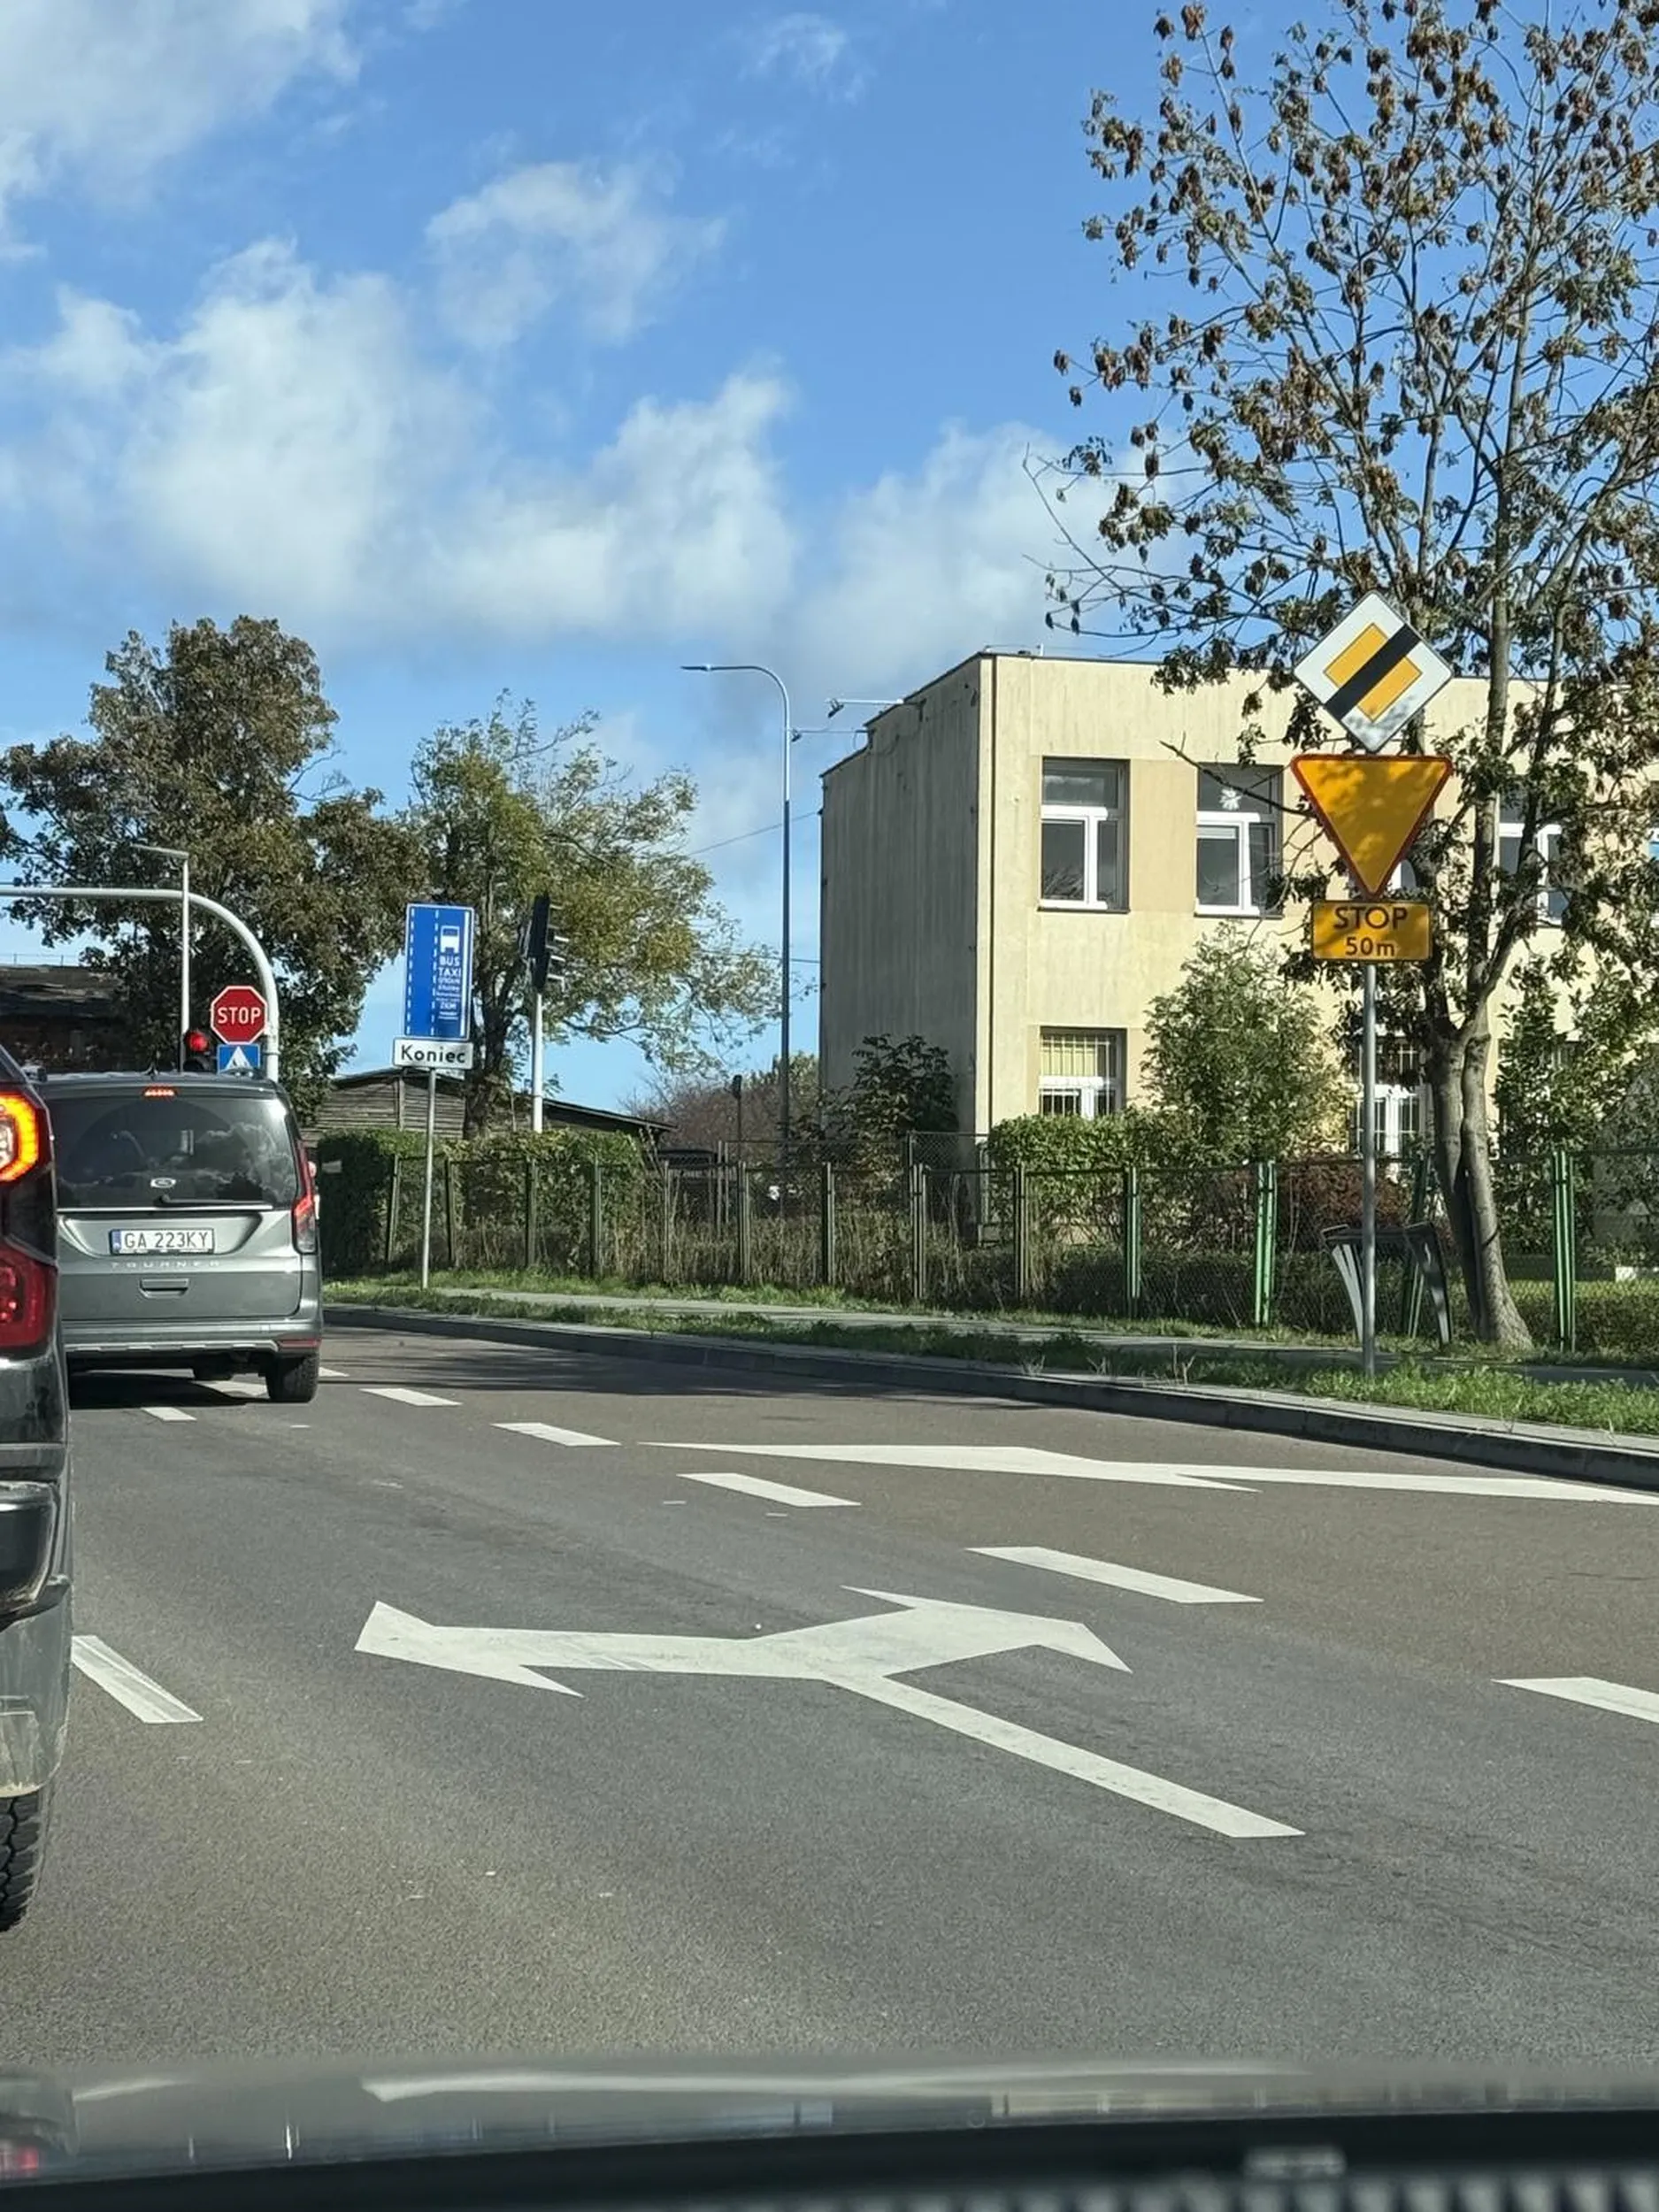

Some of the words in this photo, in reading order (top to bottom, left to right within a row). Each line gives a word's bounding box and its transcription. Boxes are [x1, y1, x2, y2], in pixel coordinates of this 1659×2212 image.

[1333, 907, 1409, 929] STOP
[1345, 937, 1395, 956] 50m
[439, 956, 460, 966] BUS
[438, 967, 461, 978] TAXI
[217, 1007, 261, 1025] STOP
[401, 1044, 465, 1064] Koniec
[124, 1233, 147, 1248] GA
[154, 1232, 209, 1248] 223KY
